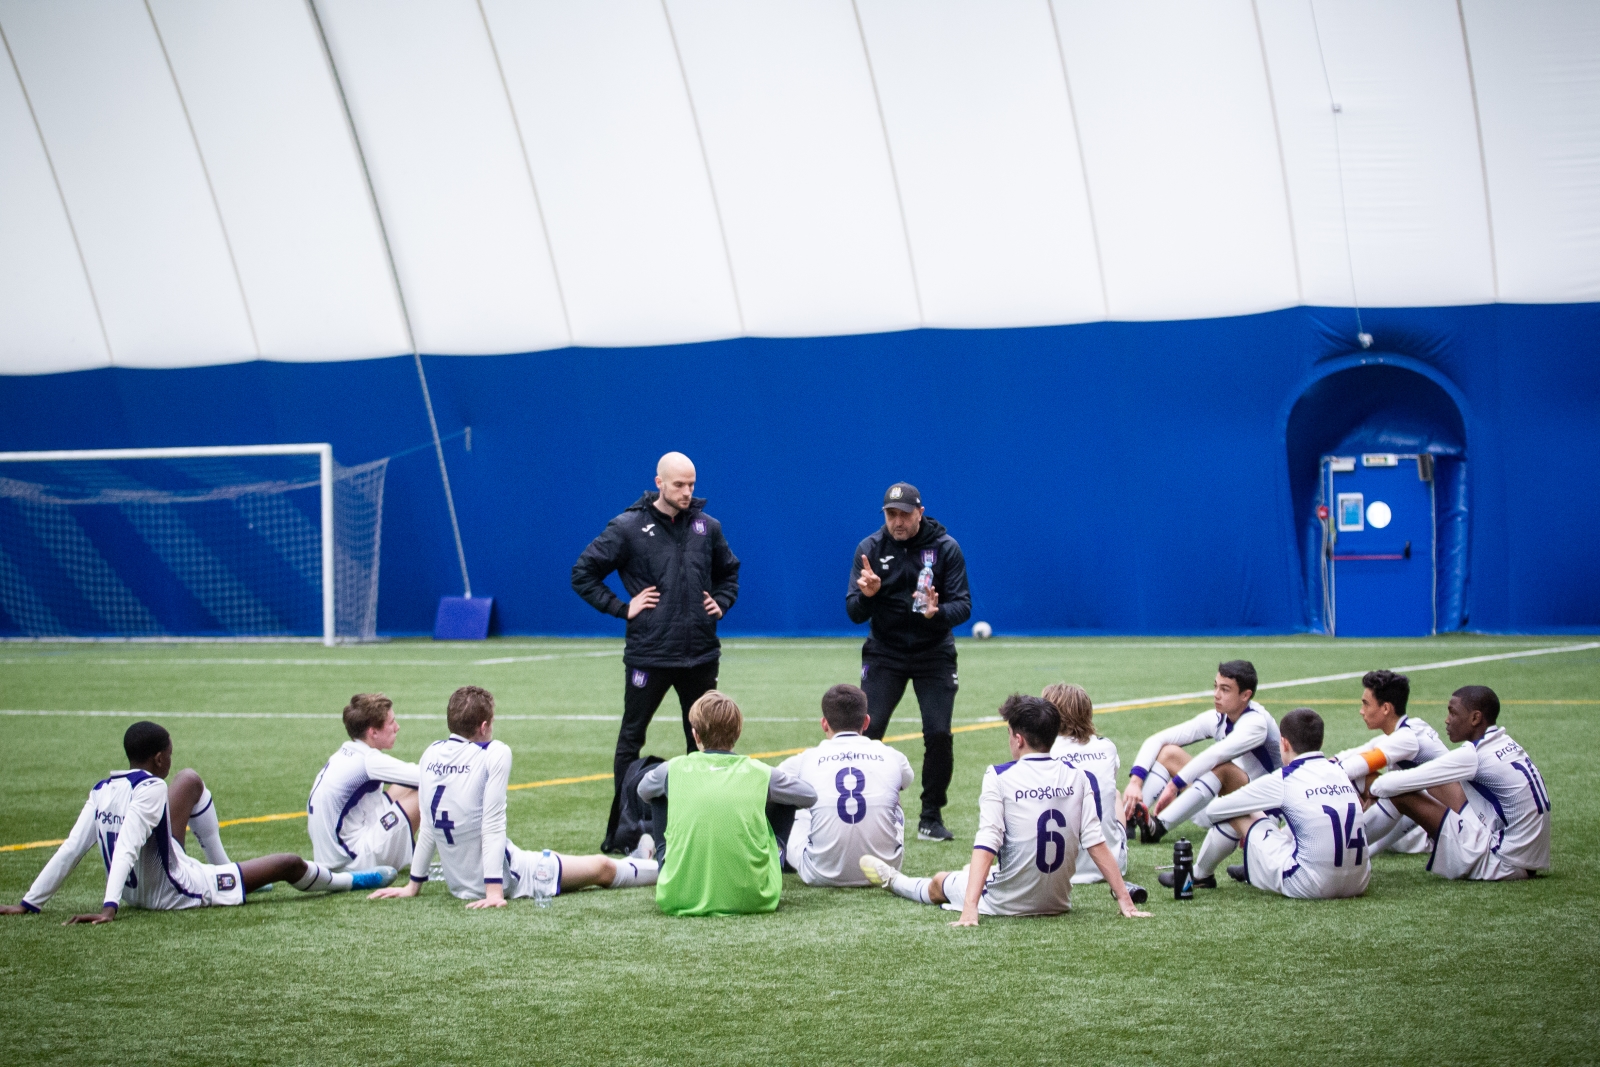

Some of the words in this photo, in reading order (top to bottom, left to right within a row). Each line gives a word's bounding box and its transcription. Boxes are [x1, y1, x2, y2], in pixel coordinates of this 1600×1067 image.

[818, 750, 885, 766] proximus
[430, 784, 455, 845] 4
[835, 766, 867, 825] 8
[1015, 785, 1075, 802] proximus
[1036, 808, 1067, 874] 6
[1322, 802, 1366, 868] 14
